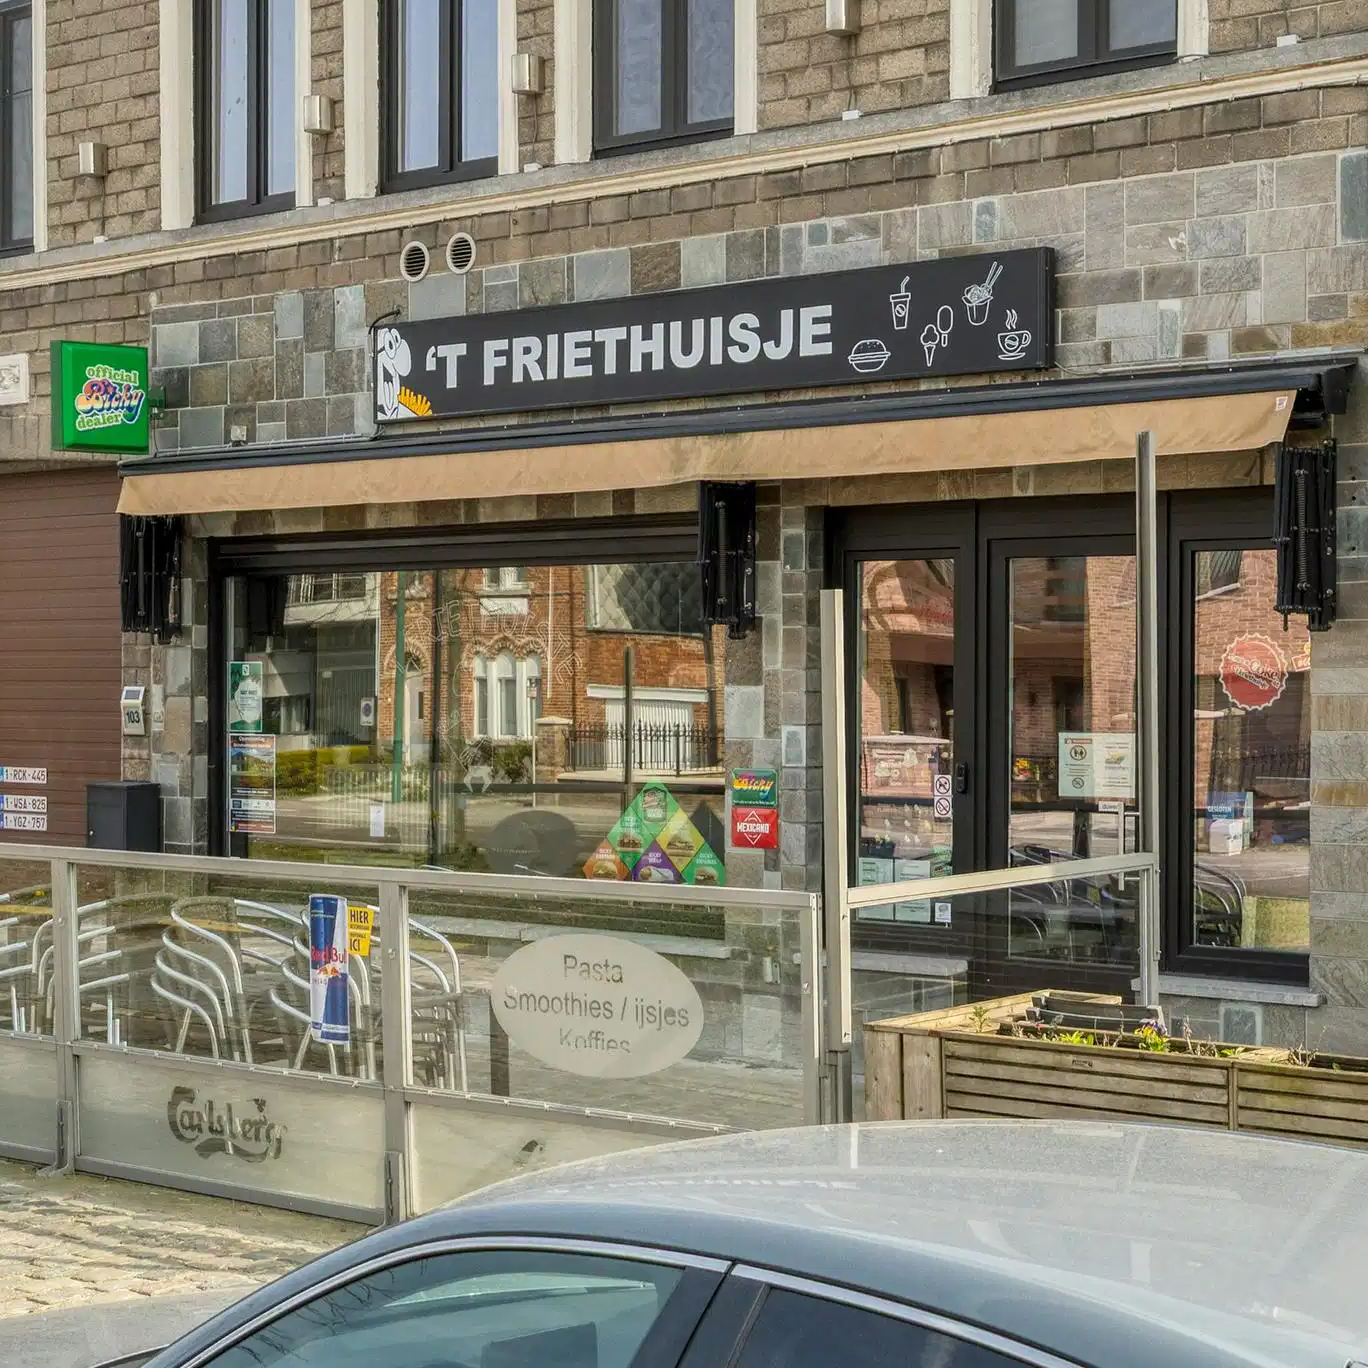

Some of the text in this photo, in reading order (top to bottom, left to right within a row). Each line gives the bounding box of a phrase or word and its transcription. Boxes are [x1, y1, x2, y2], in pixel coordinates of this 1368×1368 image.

[482, 304, 834, 387] FRIETHUISJE
[86, 365, 139, 386] official
[75, 379, 146, 424] Bicky
[76, 412, 122, 431] dealer
[126, 709, 141, 724] 103
[4, 769, 46, 782] 1-RCK-445
[4, 796, 46, 810] 1-WSA-825
[4, 813, 46, 829] 1-YGZ-757
[350, 910, 369, 924] HIER
[311, 944, 329, 963] Red
[350, 939, 361, 952] ICI
[563, 953, 623, 983] Pasta
[503, 987, 613, 1020] Smoothies
[635, 997, 690, 1031] ijsjes
[167, 1085, 288, 1160] Carlsberg
